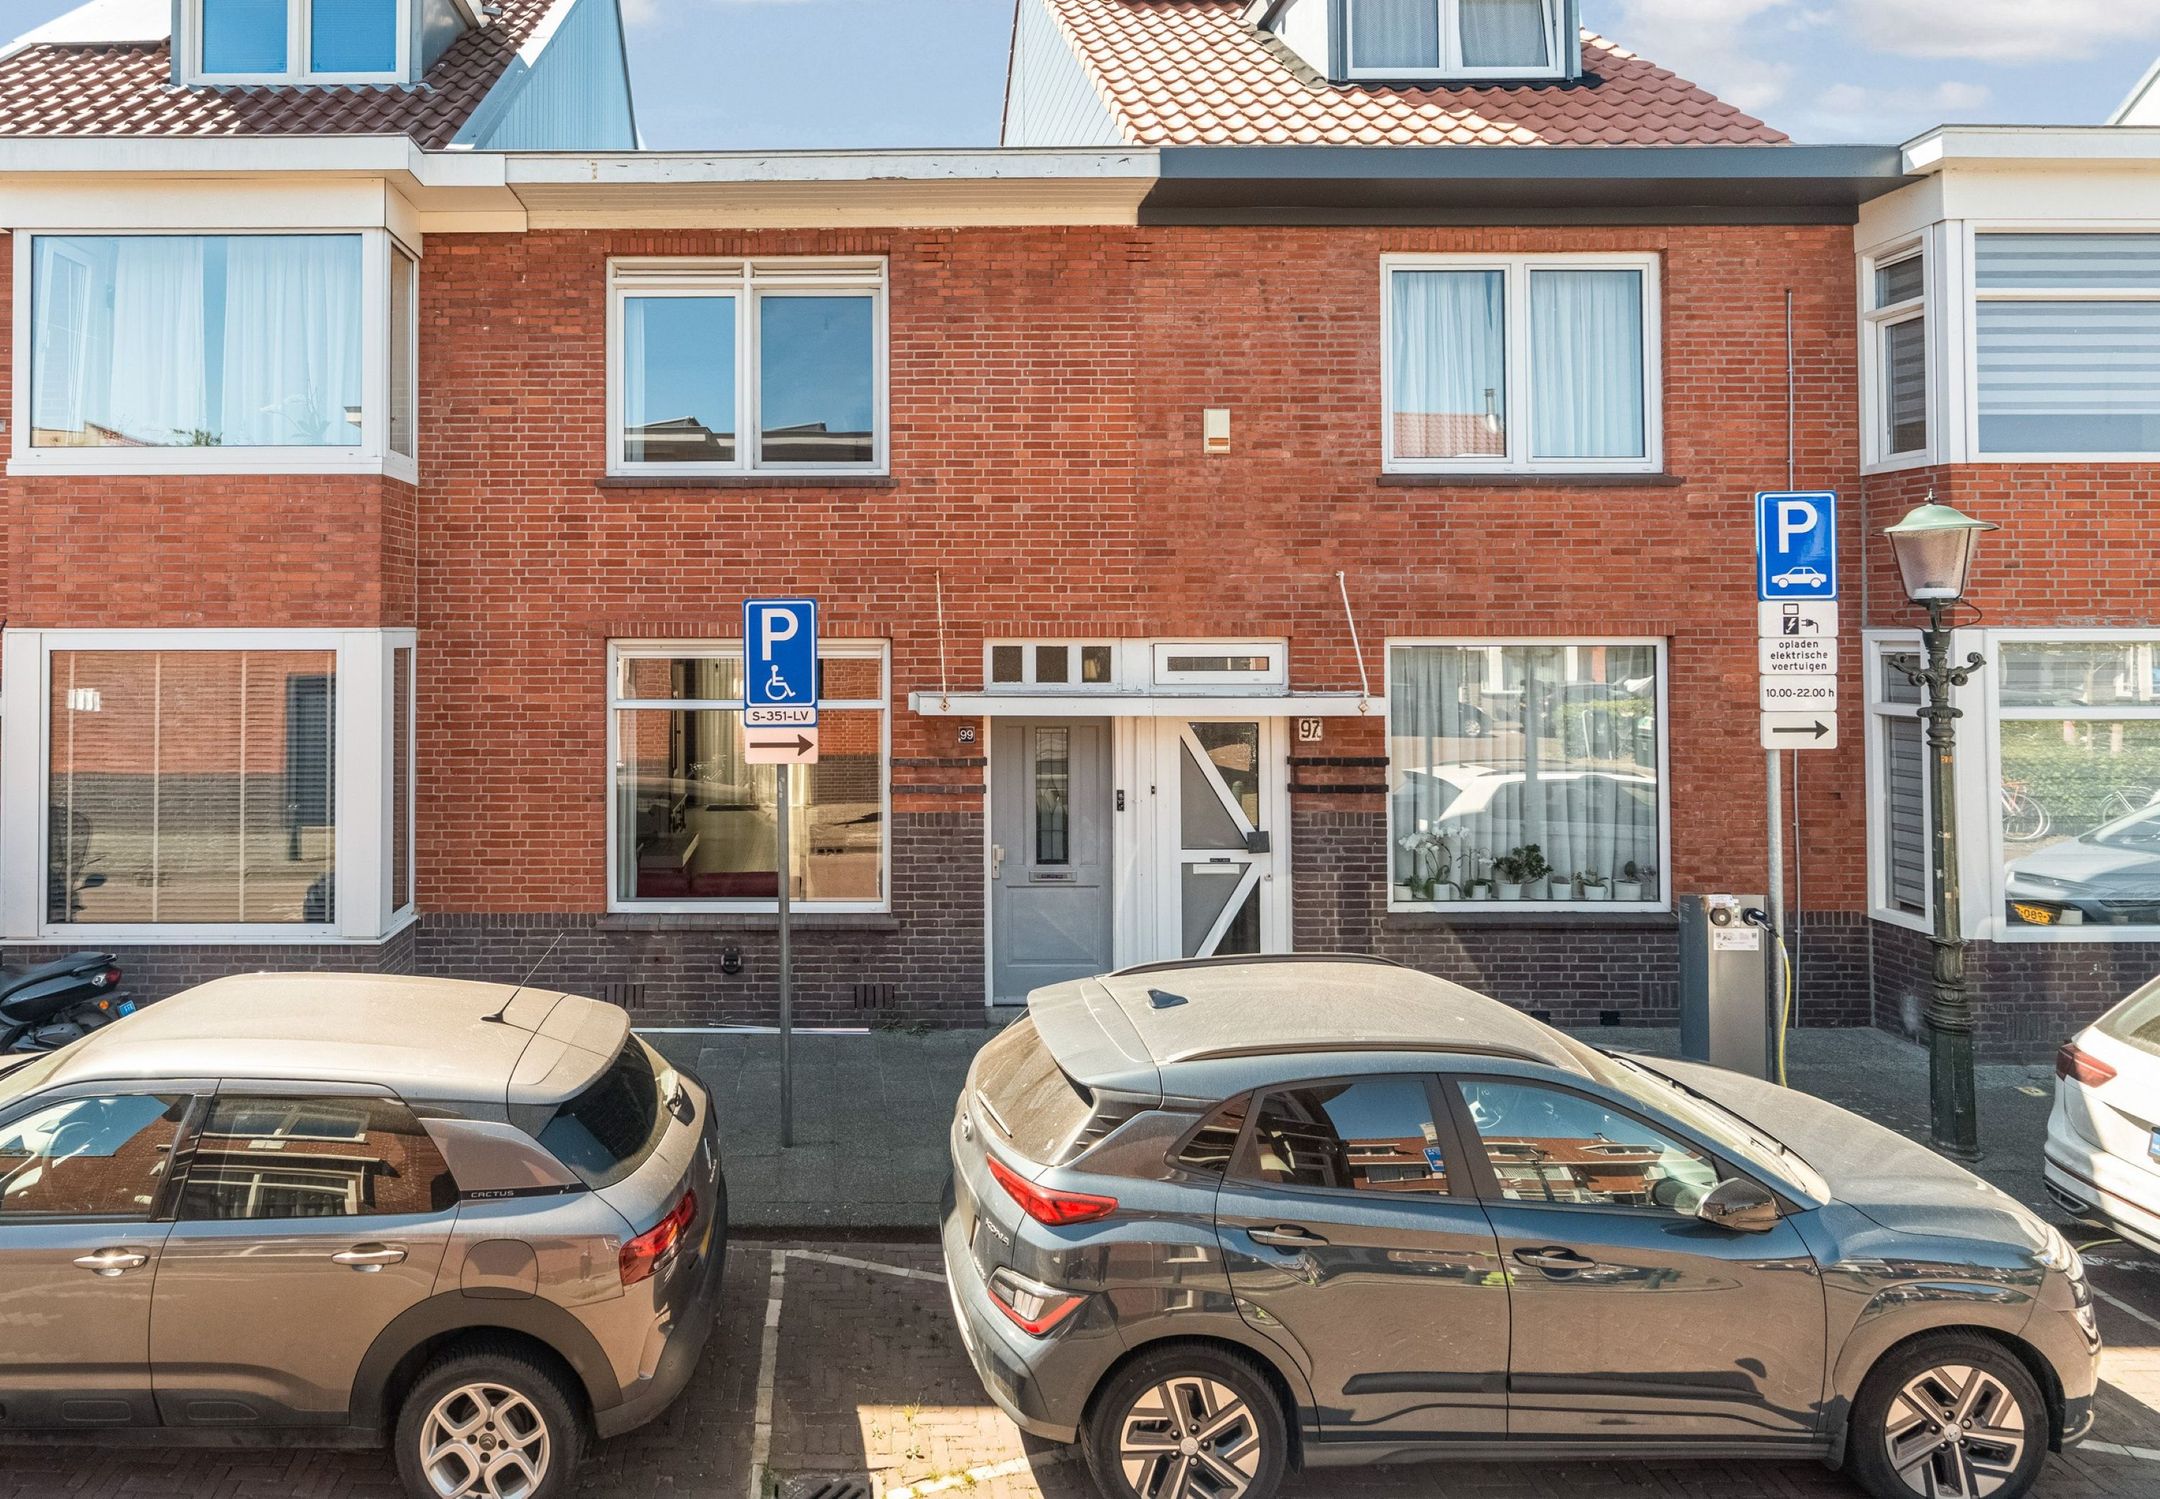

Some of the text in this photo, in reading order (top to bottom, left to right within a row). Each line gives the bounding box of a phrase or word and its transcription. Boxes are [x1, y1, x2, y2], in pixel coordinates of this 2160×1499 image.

[1778, 501, 1818, 554] P
[761, 608, 799, 661] P
[1778, 640, 1819, 649] opladen
[1770, 651, 1828, 660] elektrische
[1771, 662, 1828, 672] voertuigen
[1766, 688, 1835, 698] 10.00-22.00 h
[751, 711, 809, 721] S-351-LV
[960, 729, 974, 740] 99
[471, 1190, 514, 1198] CACTUS
